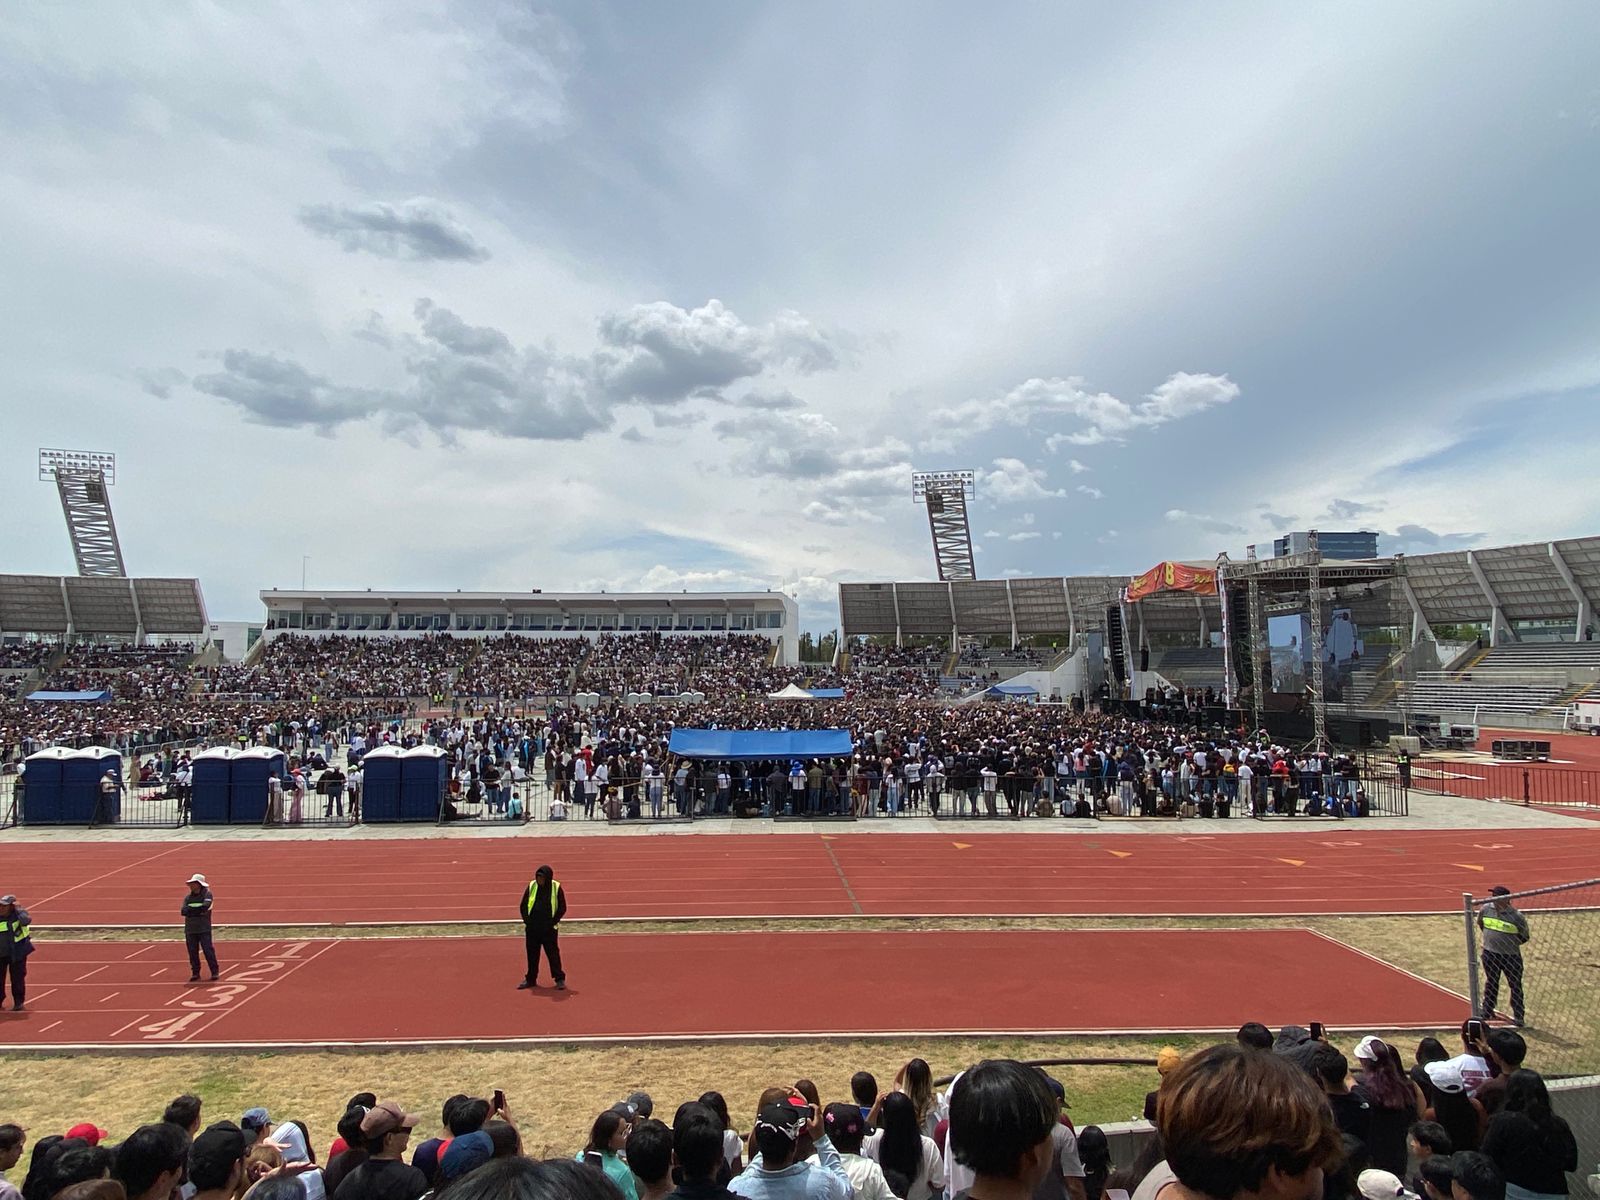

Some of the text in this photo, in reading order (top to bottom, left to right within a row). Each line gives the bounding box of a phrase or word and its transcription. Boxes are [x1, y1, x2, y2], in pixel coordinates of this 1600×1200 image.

[265, 941, 311, 959] 1
[225, 961, 286, 982] 2
[181, 984, 248, 1008] 3
[138, 1011, 205, 1039] 4
